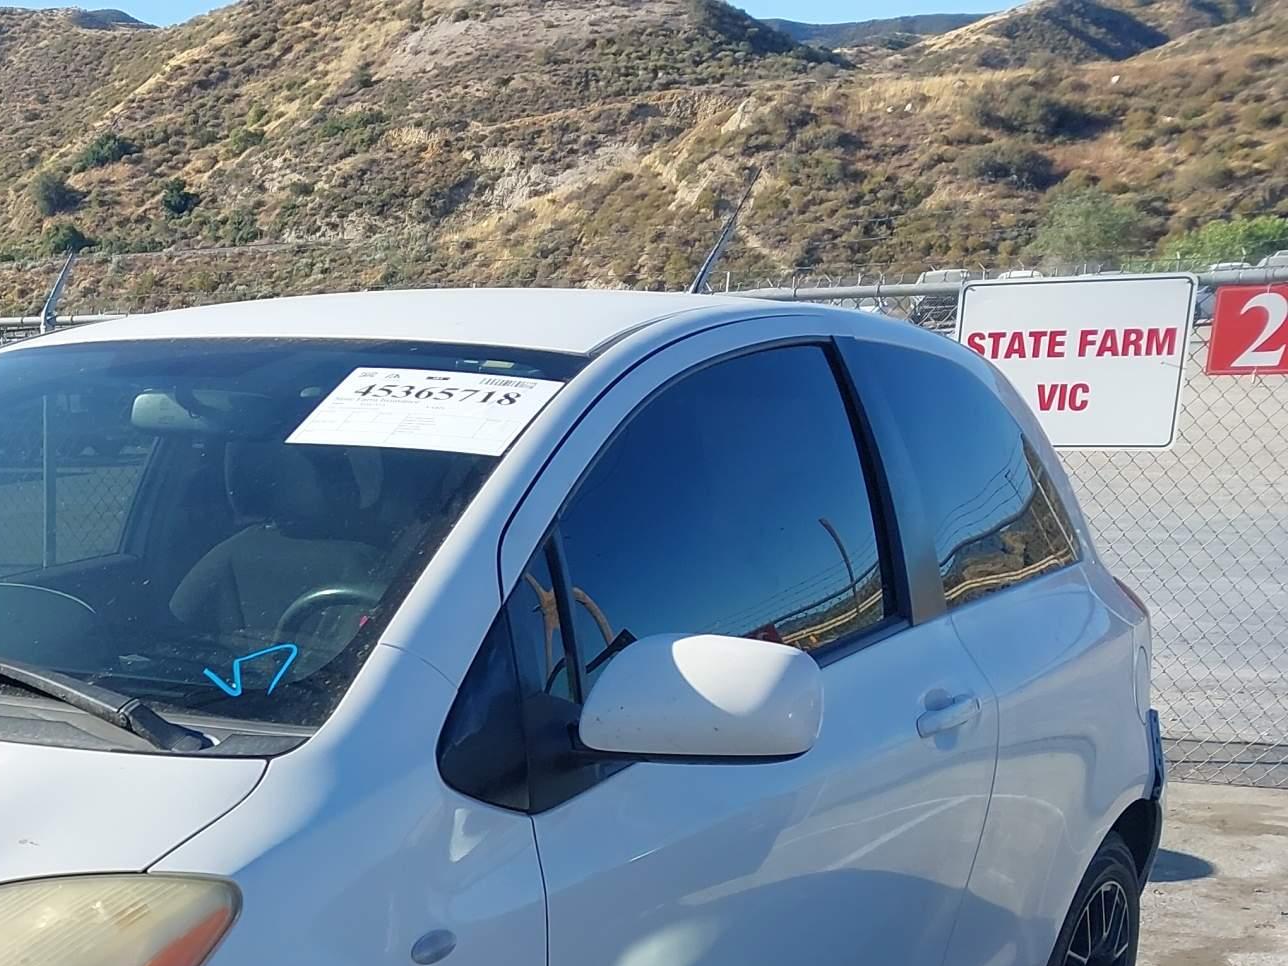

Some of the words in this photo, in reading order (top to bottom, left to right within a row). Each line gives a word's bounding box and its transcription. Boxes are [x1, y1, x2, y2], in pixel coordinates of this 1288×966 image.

[967, 330, 1067, 359] STATE
[1077, 327, 1178, 358] FARM
[1230, 292, 1288, 368] 2
[354, 382, 522, 407] 45365718
[1036, 383, 1090, 412] VIC
